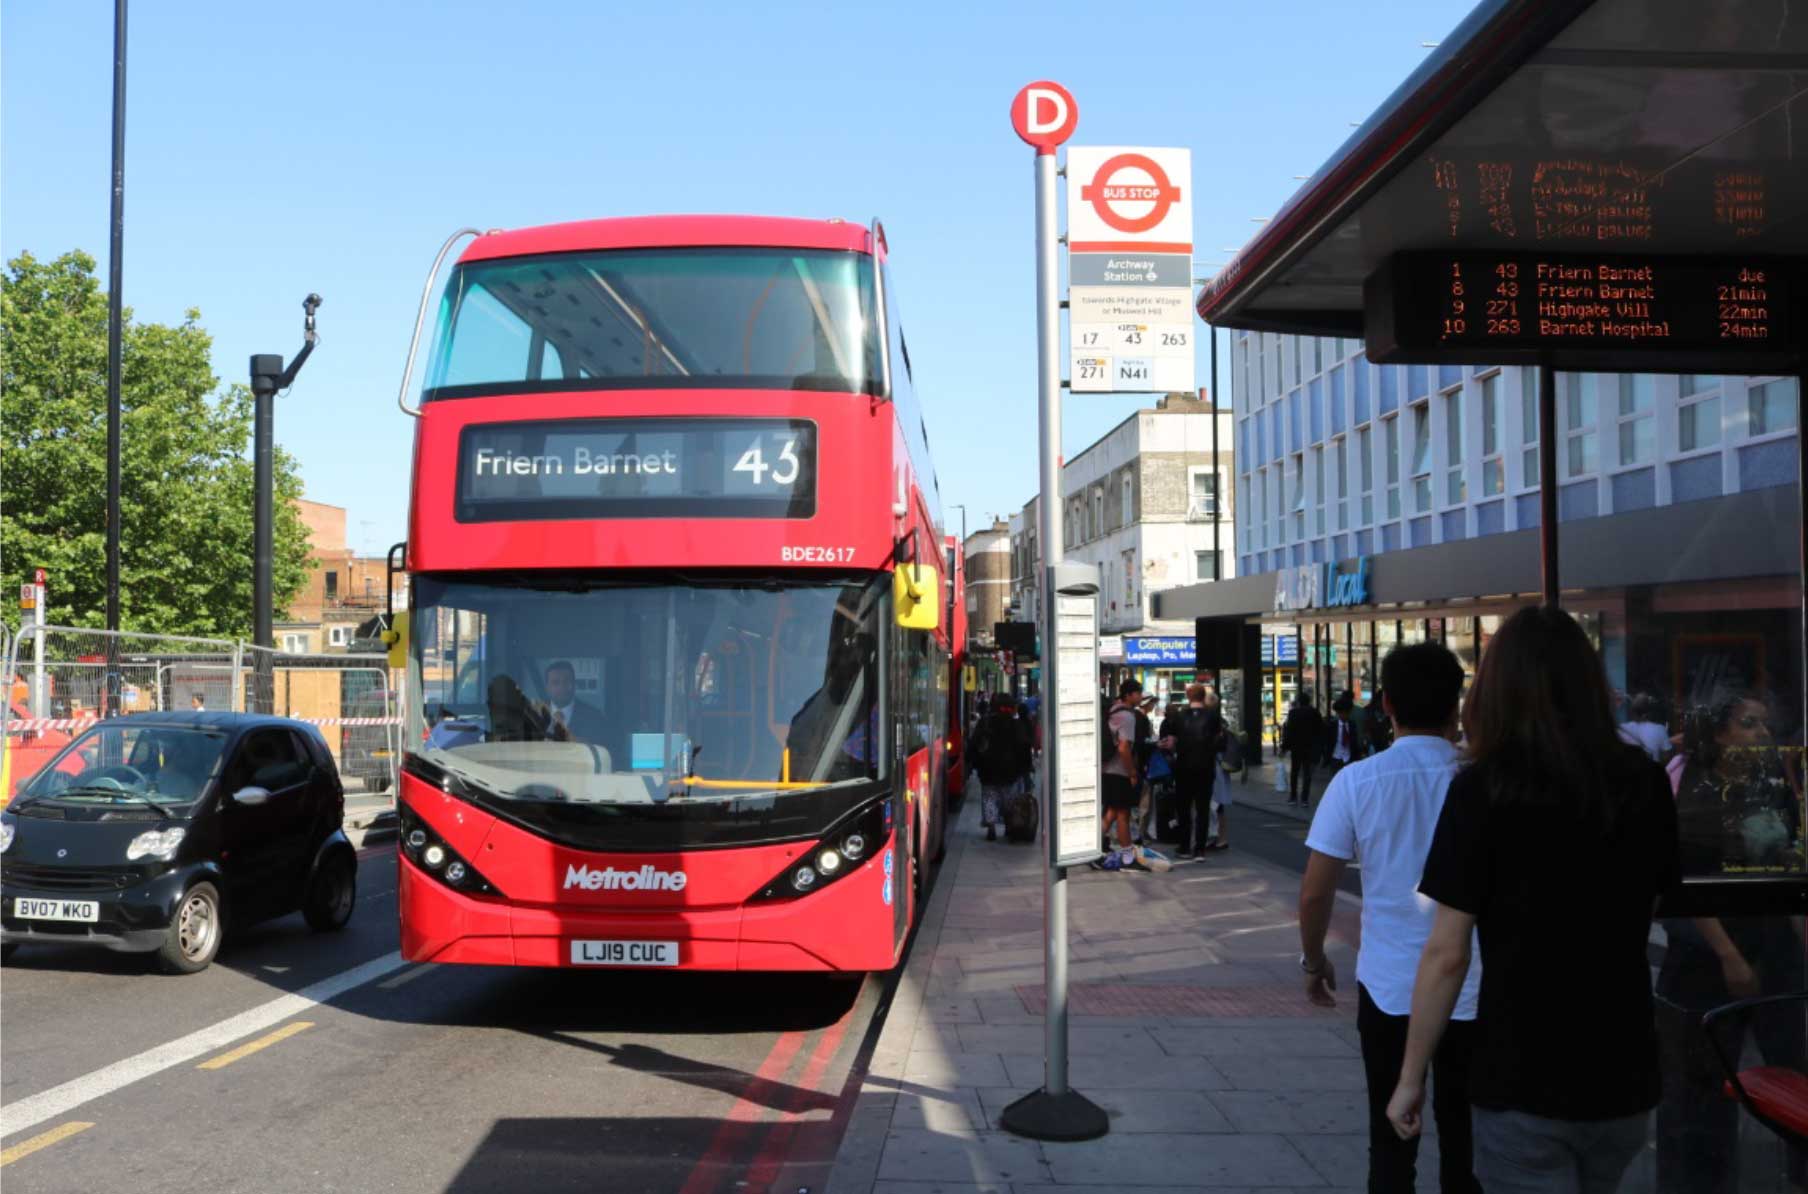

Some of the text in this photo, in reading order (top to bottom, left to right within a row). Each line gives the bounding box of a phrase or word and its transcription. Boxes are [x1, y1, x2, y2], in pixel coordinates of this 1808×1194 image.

[1027, 89, 1068, 134] D
[1103, 187, 1160, 199] BUS STOP
[1107, 259, 1155, 272] Archway
[1452, 263, 1766, 283] 1 43 Friern Barnet due
[1104, 272, 1143, 282] Station
[1452, 282, 1767, 301] 8 43 Friern Barnet 21min
[1453, 301, 1768, 320] 9 271 Highgate Vill 22min
[1083, 332, 1187, 346] 17 43 263
[1444, 320, 1768, 339] 10 263 Barnet Hospital 24min
[1081, 367, 1149, 380] 271 N41
[476, 432, 801, 485] Friern Barnet 43
[781, 547, 856, 563] BDE2617
[1327, 556, 1368, 606] Local
[1138, 639, 1189, 651] Computer
[563, 864, 687, 891] Metroline
[20, 901, 57, 917] BV07
[582, 943, 666, 962] LJ19 CUC
